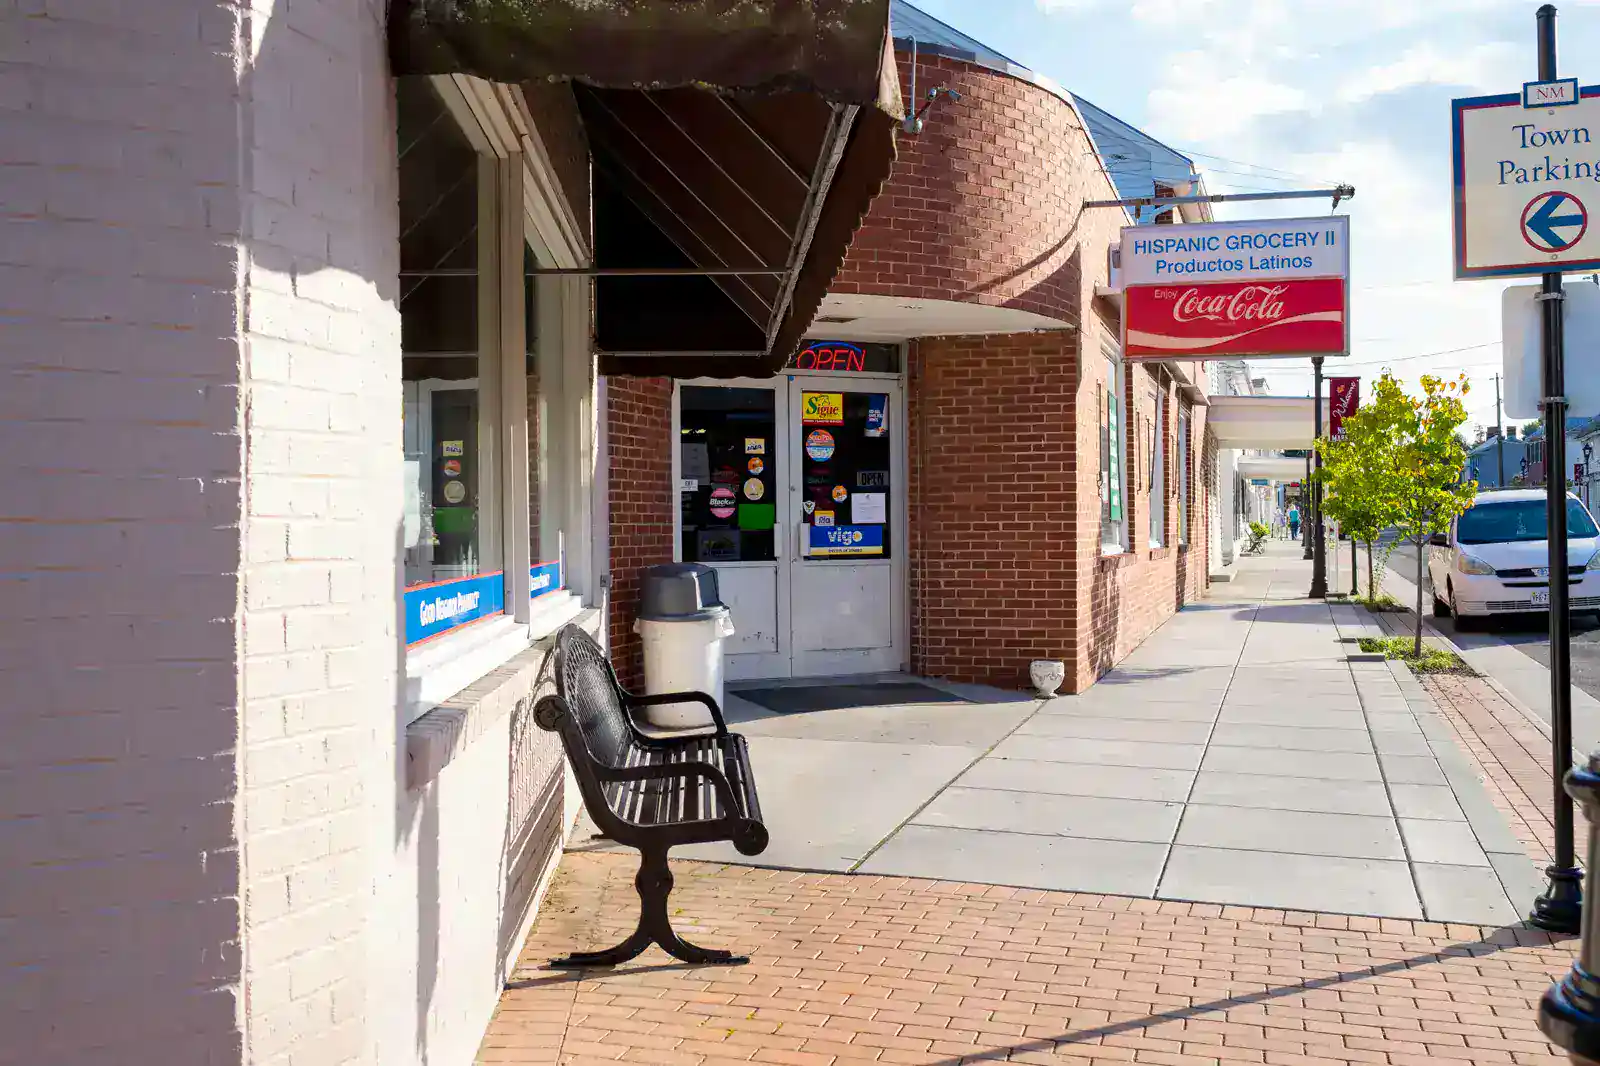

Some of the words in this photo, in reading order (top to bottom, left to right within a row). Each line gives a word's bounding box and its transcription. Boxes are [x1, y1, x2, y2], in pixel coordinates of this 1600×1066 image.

[1536, 86, 1565, 100] NM
[1511, 124, 1591, 149] Town
[1134, 236, 1220, 255] HISPANIC
[1225, 232, 1319, 252] GROCERY
[1325, 230, 1335, 246] II
[1156, 258, 1244, 275] Productos
[1249, 254, 1313, 270] Latinos
[1154, 289, 1178, 300] Enjoy
[797, 348, 867, 372] OPEN
[806, 396, 839, 418] Sigue
[1332, 380, 1357, 419] Welcome
[861, 472, 885, 486] OPEN
[709, 498, 729, 507] Black
[827, 526, 863, 546] vigo
